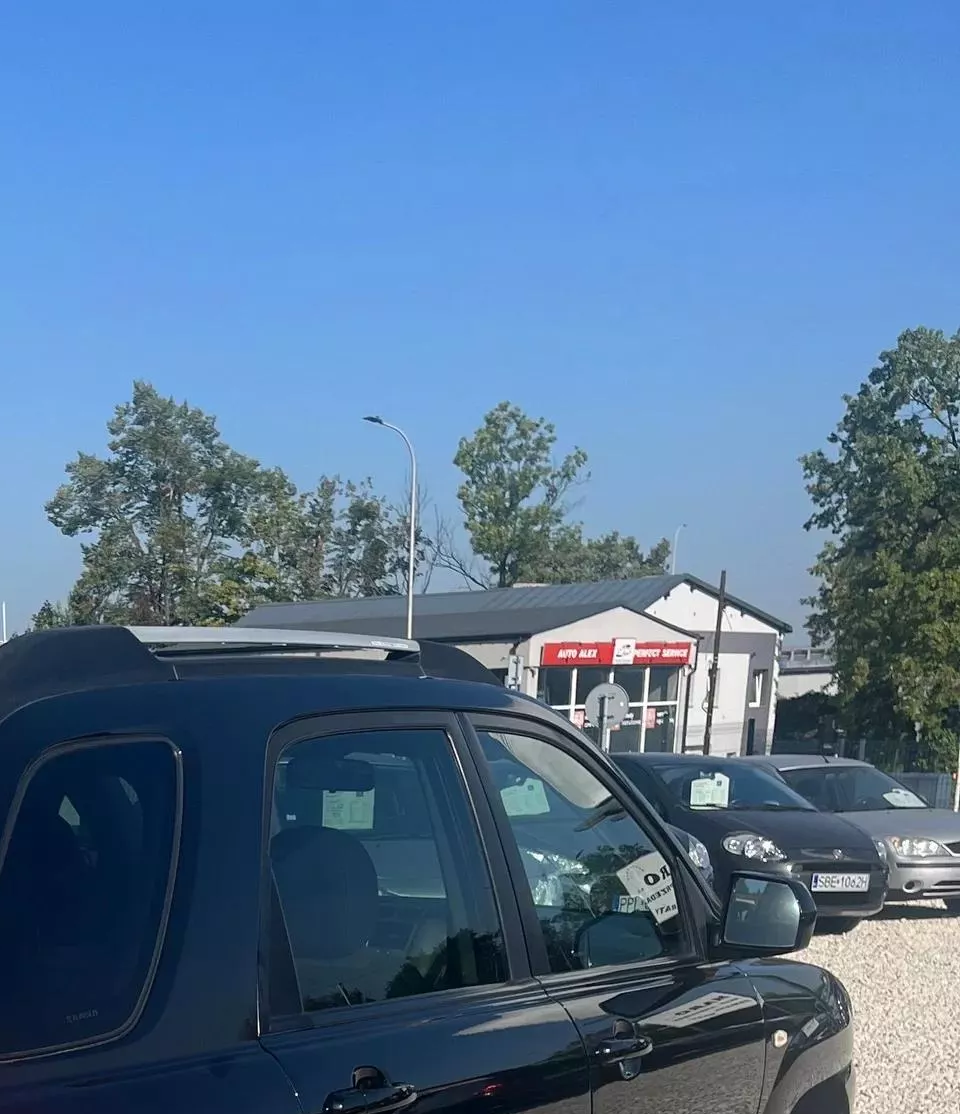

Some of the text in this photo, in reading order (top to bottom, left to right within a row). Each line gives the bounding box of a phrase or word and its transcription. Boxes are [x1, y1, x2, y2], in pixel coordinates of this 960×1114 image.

[557, 648, 598, 659] AUTO ALEX
[662, 648, 689, 658] SERVICE
[819, 875, 837, 888] SBE
